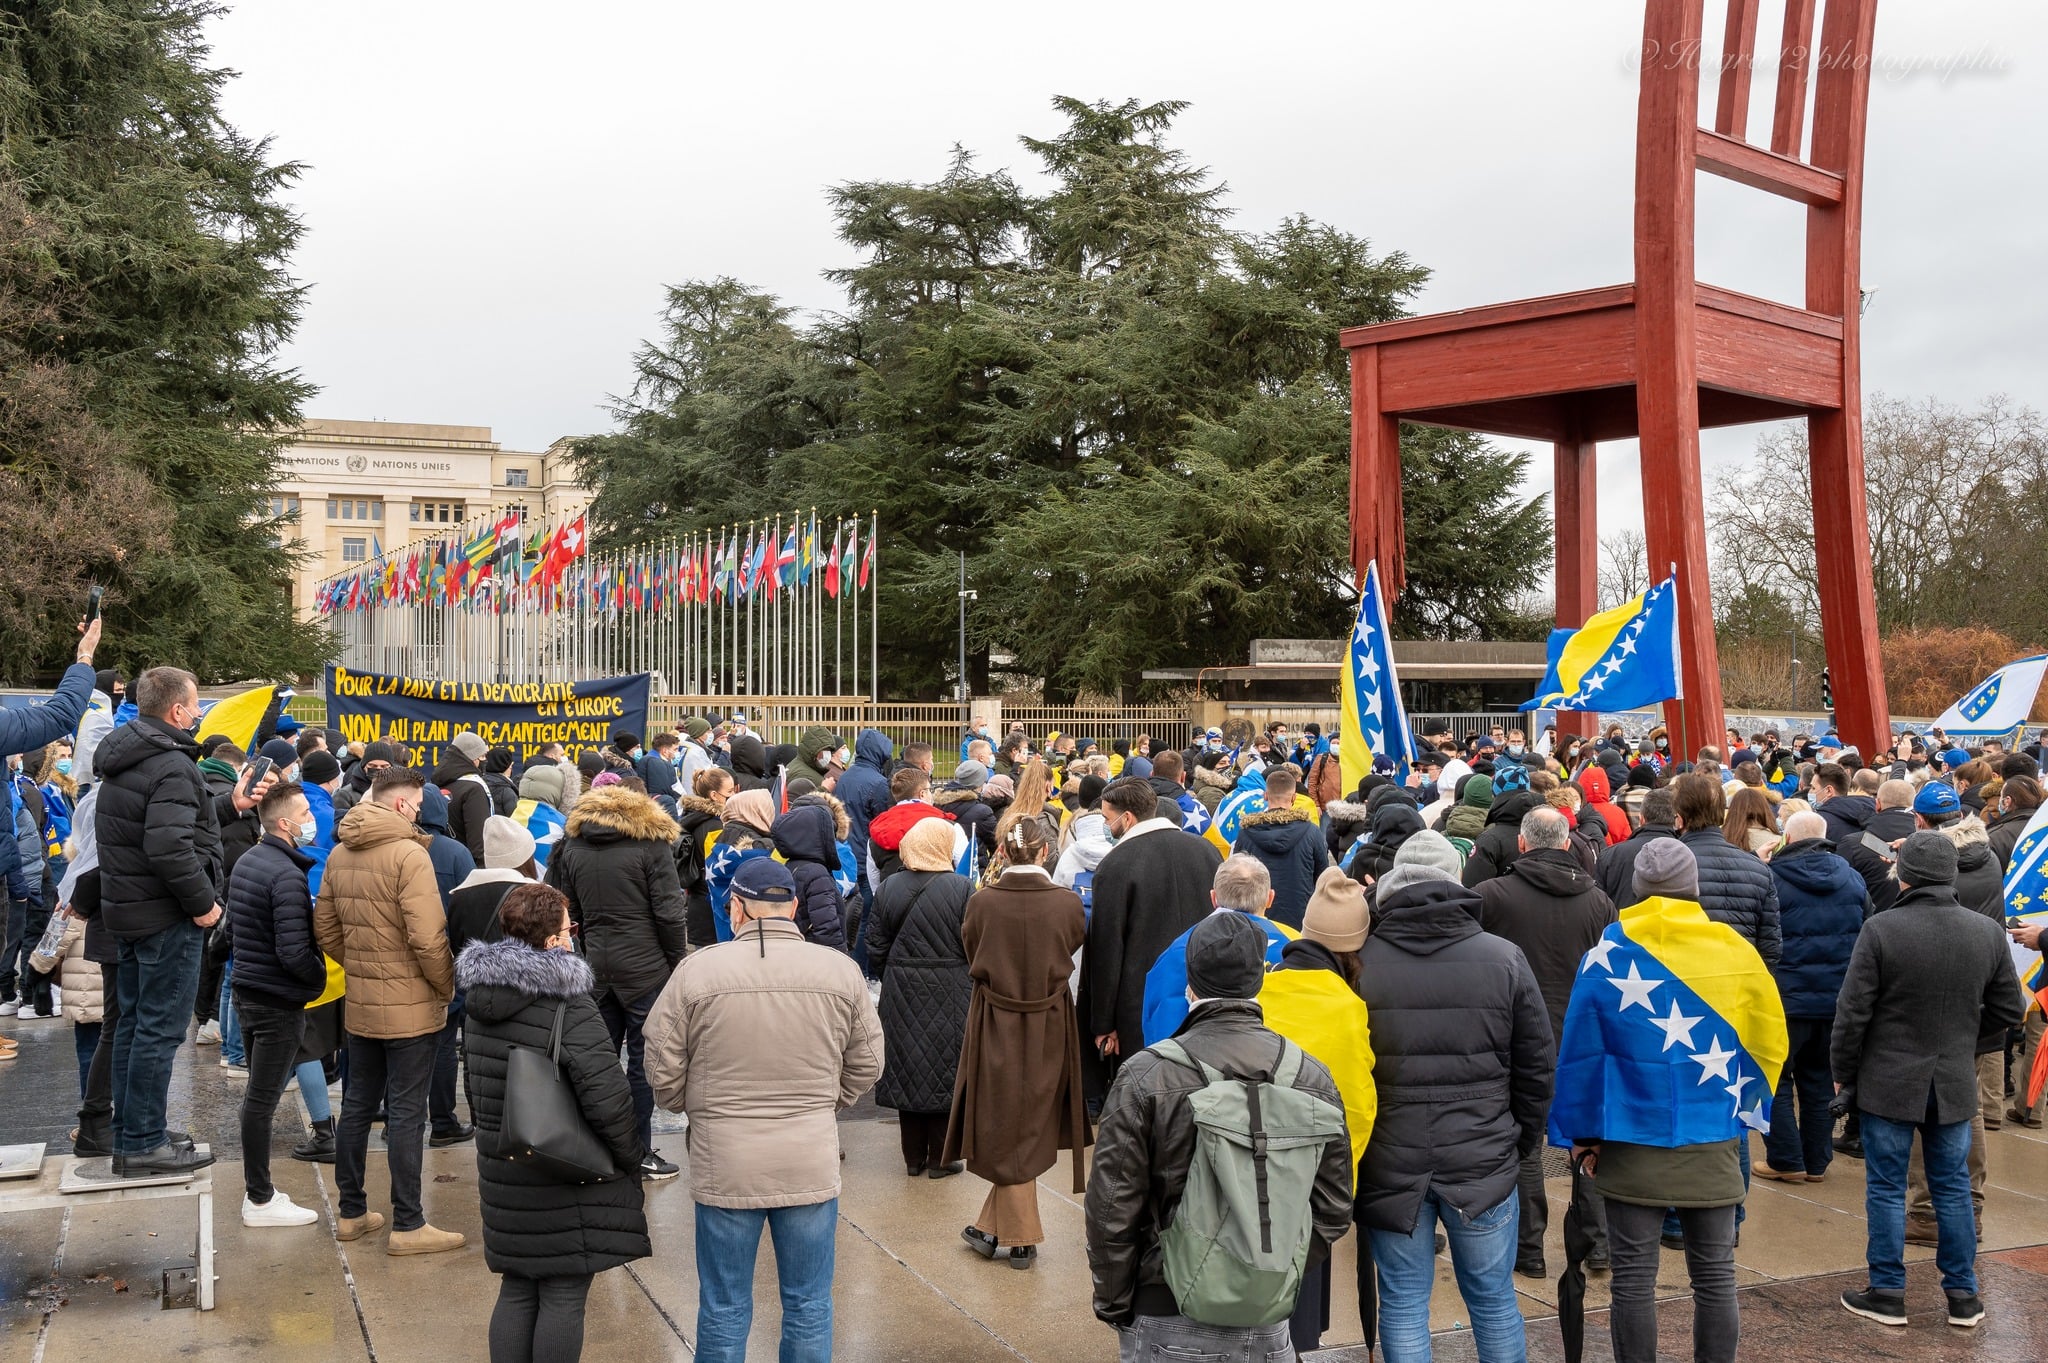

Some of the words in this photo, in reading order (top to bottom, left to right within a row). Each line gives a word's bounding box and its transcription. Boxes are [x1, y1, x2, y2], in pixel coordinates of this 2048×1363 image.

[296, 457, 340, 466] NATIONS
[372, 460, 418, 469] NATIONS
[421, 461, 451, 471] UNIES
[377, 676, 398, 695] LA
[402, 676, 436, 699] PAIX
[440, 681, 457, 701] ET
[463, 682, 480, 701] LA
[538, 703, 558, 716] EN
[564, 697, 624, 717] EUROPE
[339, 714, 380, 743] NON
[388, 718, 408, 742] AU
[413, 720, 448, 742] PLAN
